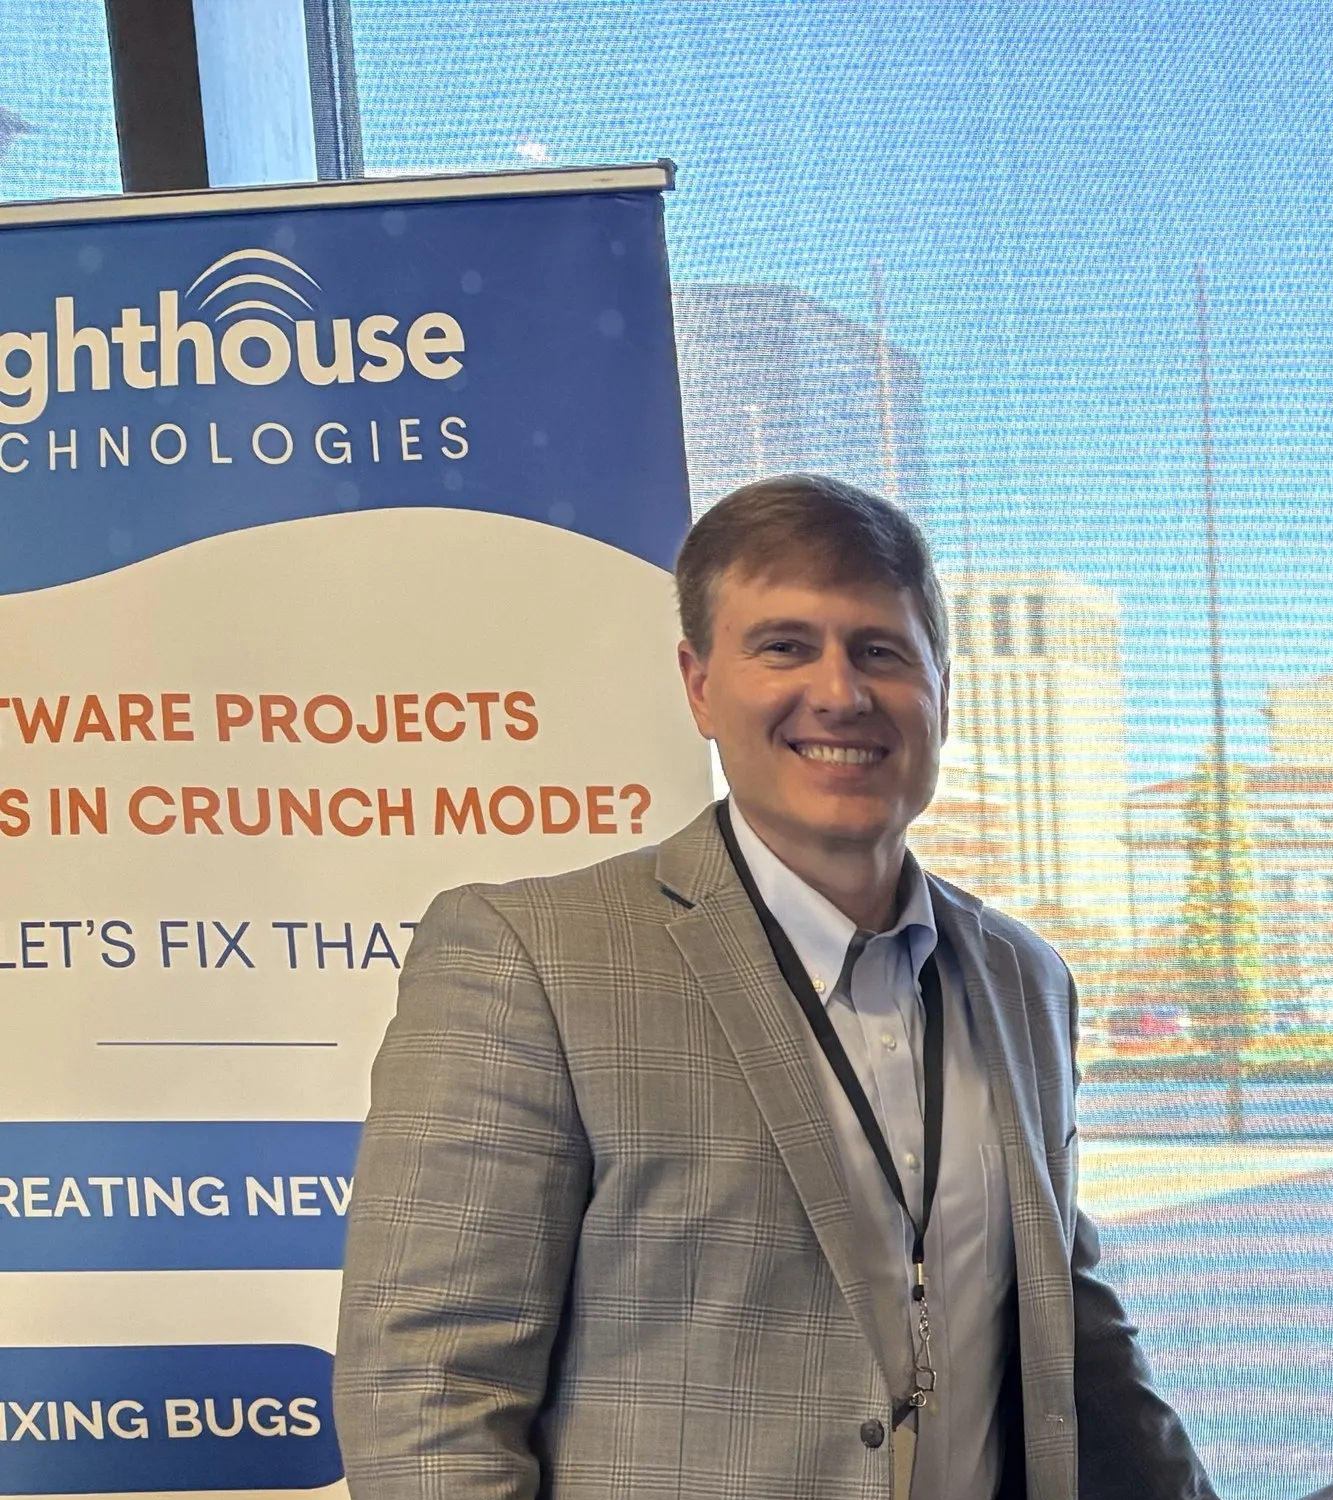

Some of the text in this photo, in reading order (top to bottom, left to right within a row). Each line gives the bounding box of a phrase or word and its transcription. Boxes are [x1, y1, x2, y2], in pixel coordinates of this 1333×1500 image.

[0, 290, 465, 424] ghthouse
[0, 416, 469, 473] CHNOLOGIES
[0, 691, 539, 744] WARE PROJECTS
[50, 787, 108, 836] IN
[128, 786, 415, 837] CRUNCH
[434, 783, 652, 836] MODE?
[161, 920, 255, 969] FIX
[167, 1397, 321, 1440] BUGS
